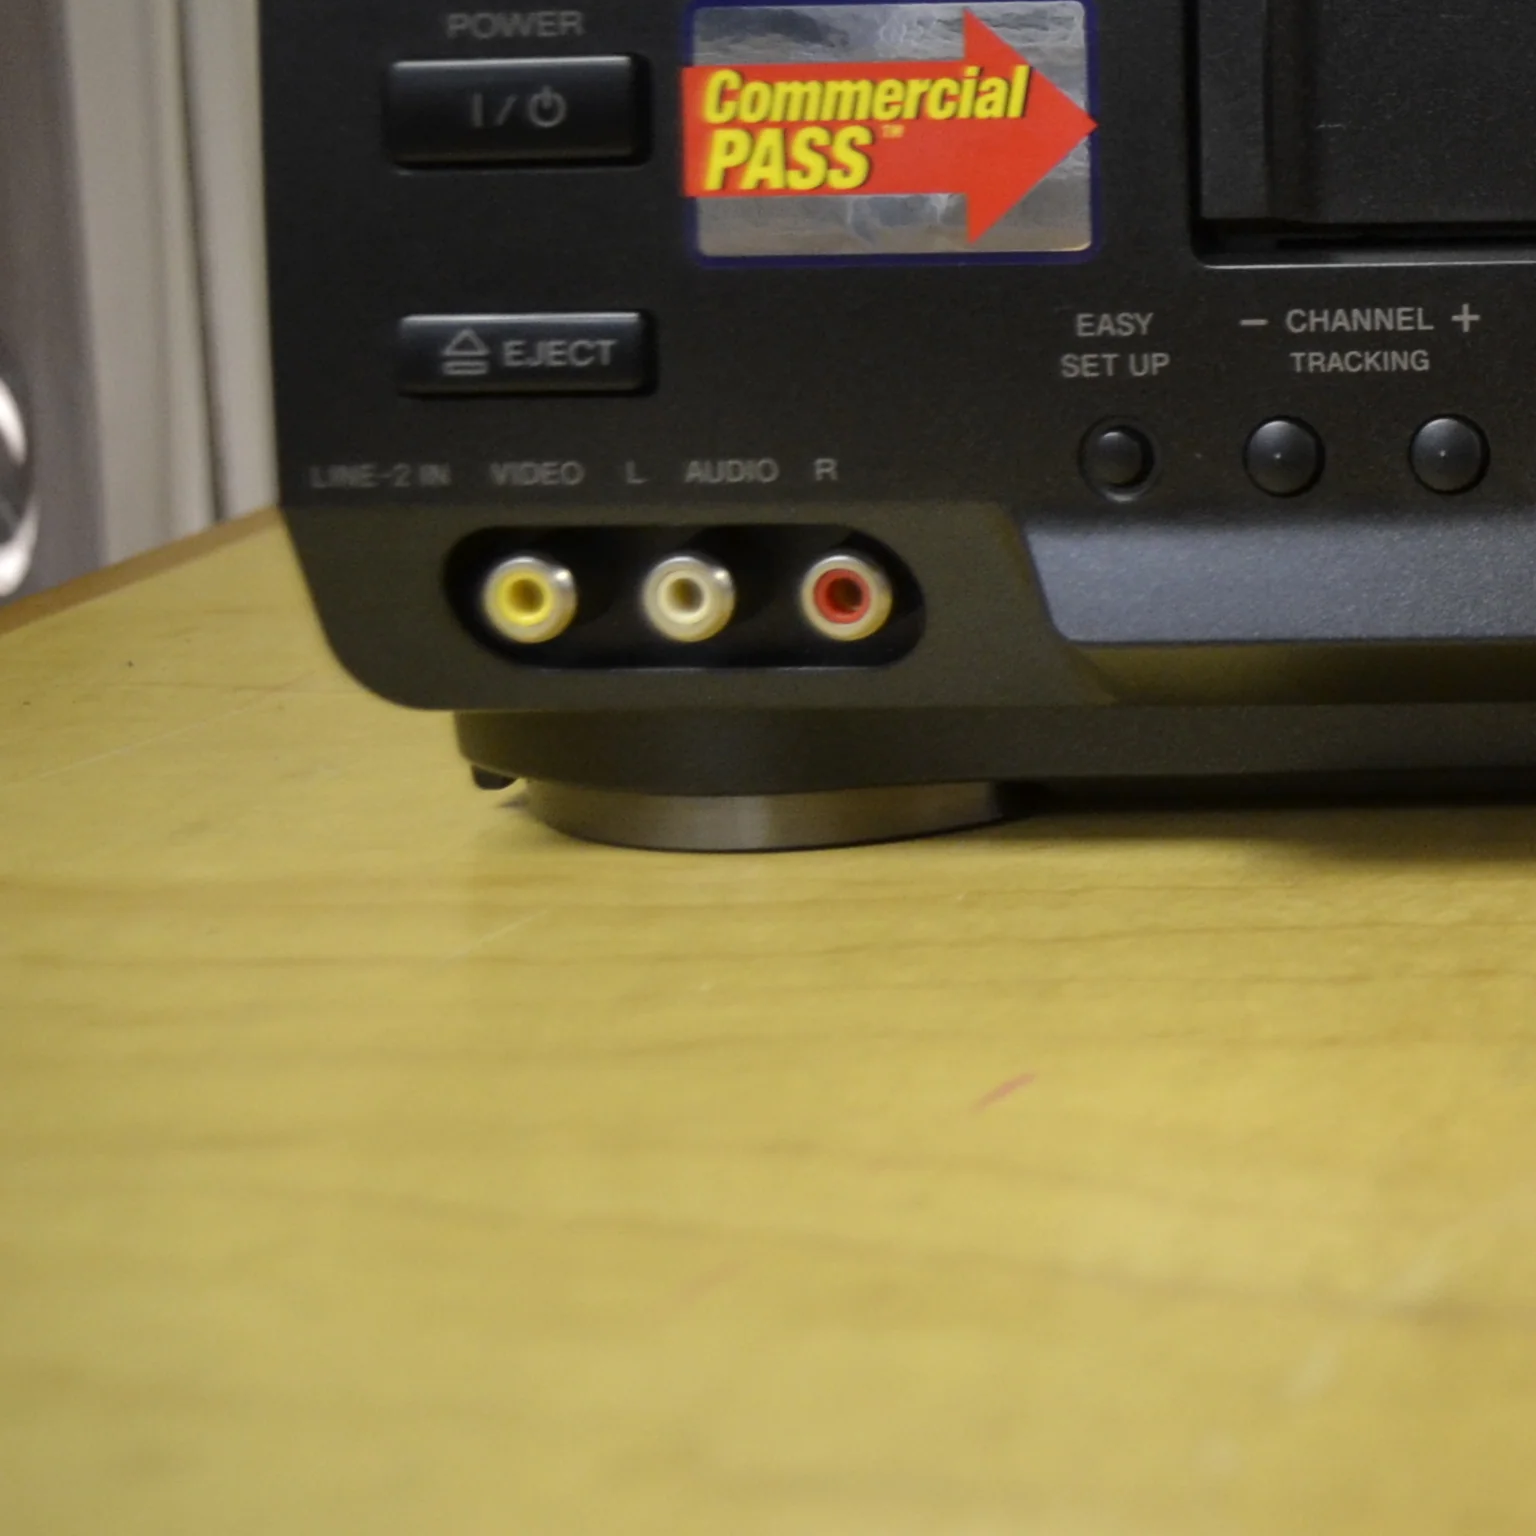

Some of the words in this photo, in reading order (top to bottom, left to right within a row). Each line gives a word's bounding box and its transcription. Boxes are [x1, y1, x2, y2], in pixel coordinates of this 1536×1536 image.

[447, 10, 583, 40] POWER
[702, 66, 1031, 122] Commercial
[703, 126, 875, 191] PASS
[1075, 312, 1154, 336] EASY
[1285, 307, 1434, 333] CHANNEL
[503, 339, 617, 367] EJECT
[1060, 353, 1121, 378] SET
[1129, 353, 1170, 377] UP
[1290, 350, 1431, 373] TRACKING
[489, 461, 584, 485] VIDEO
[626, 460, 646, 484] L
[684, 458, 779, 484] AUDIO
[815, 457, 838, 482] R
